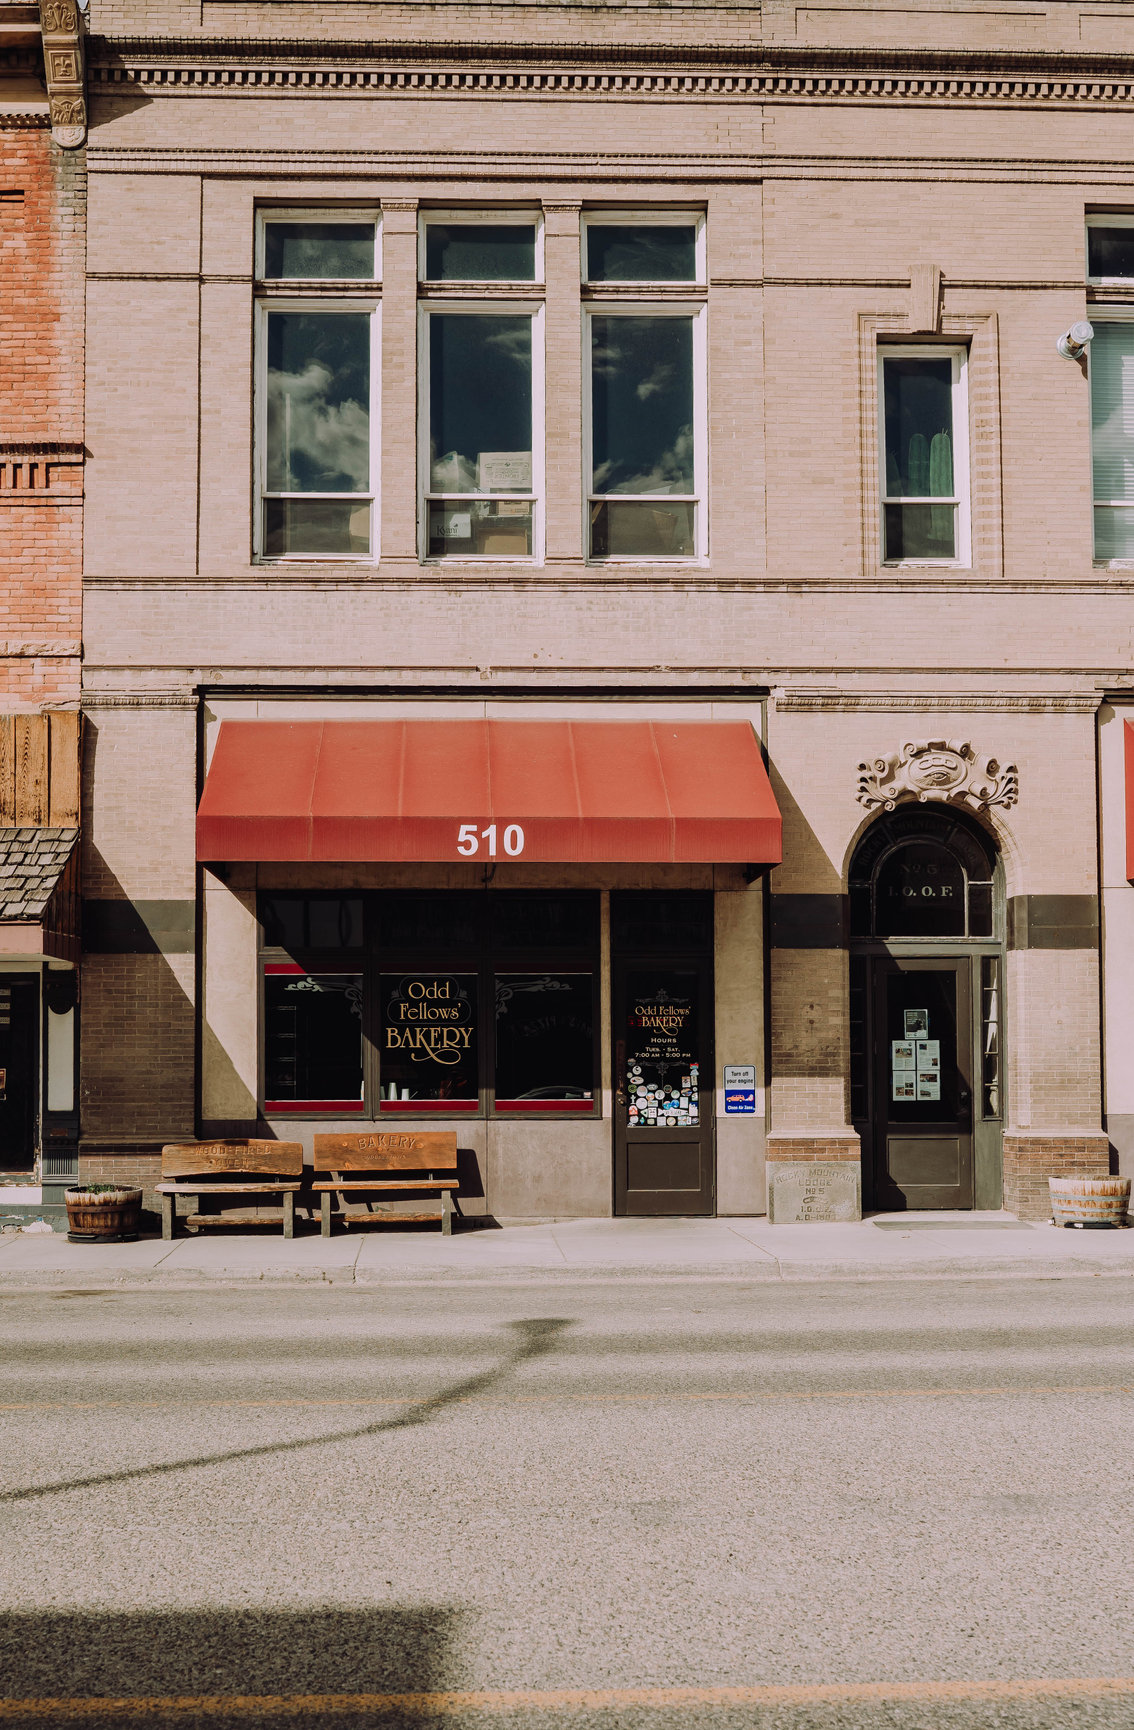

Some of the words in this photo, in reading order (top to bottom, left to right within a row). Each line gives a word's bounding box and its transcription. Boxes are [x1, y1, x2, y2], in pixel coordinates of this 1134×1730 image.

[457, 824, 525, 856] 510
[408, 981, 450, 999] Odd
[400, 1002, 461, 1020] Fellows'
[635, 1006, 657, 1015] Odd
[659, 1005, 691, 1015] Fellows'
[642, 1016, 684, 1036] BAKERY
[386, 1027, 474, 1065] BAKERY
[358, 1134, 416, 1150] BAKERY
